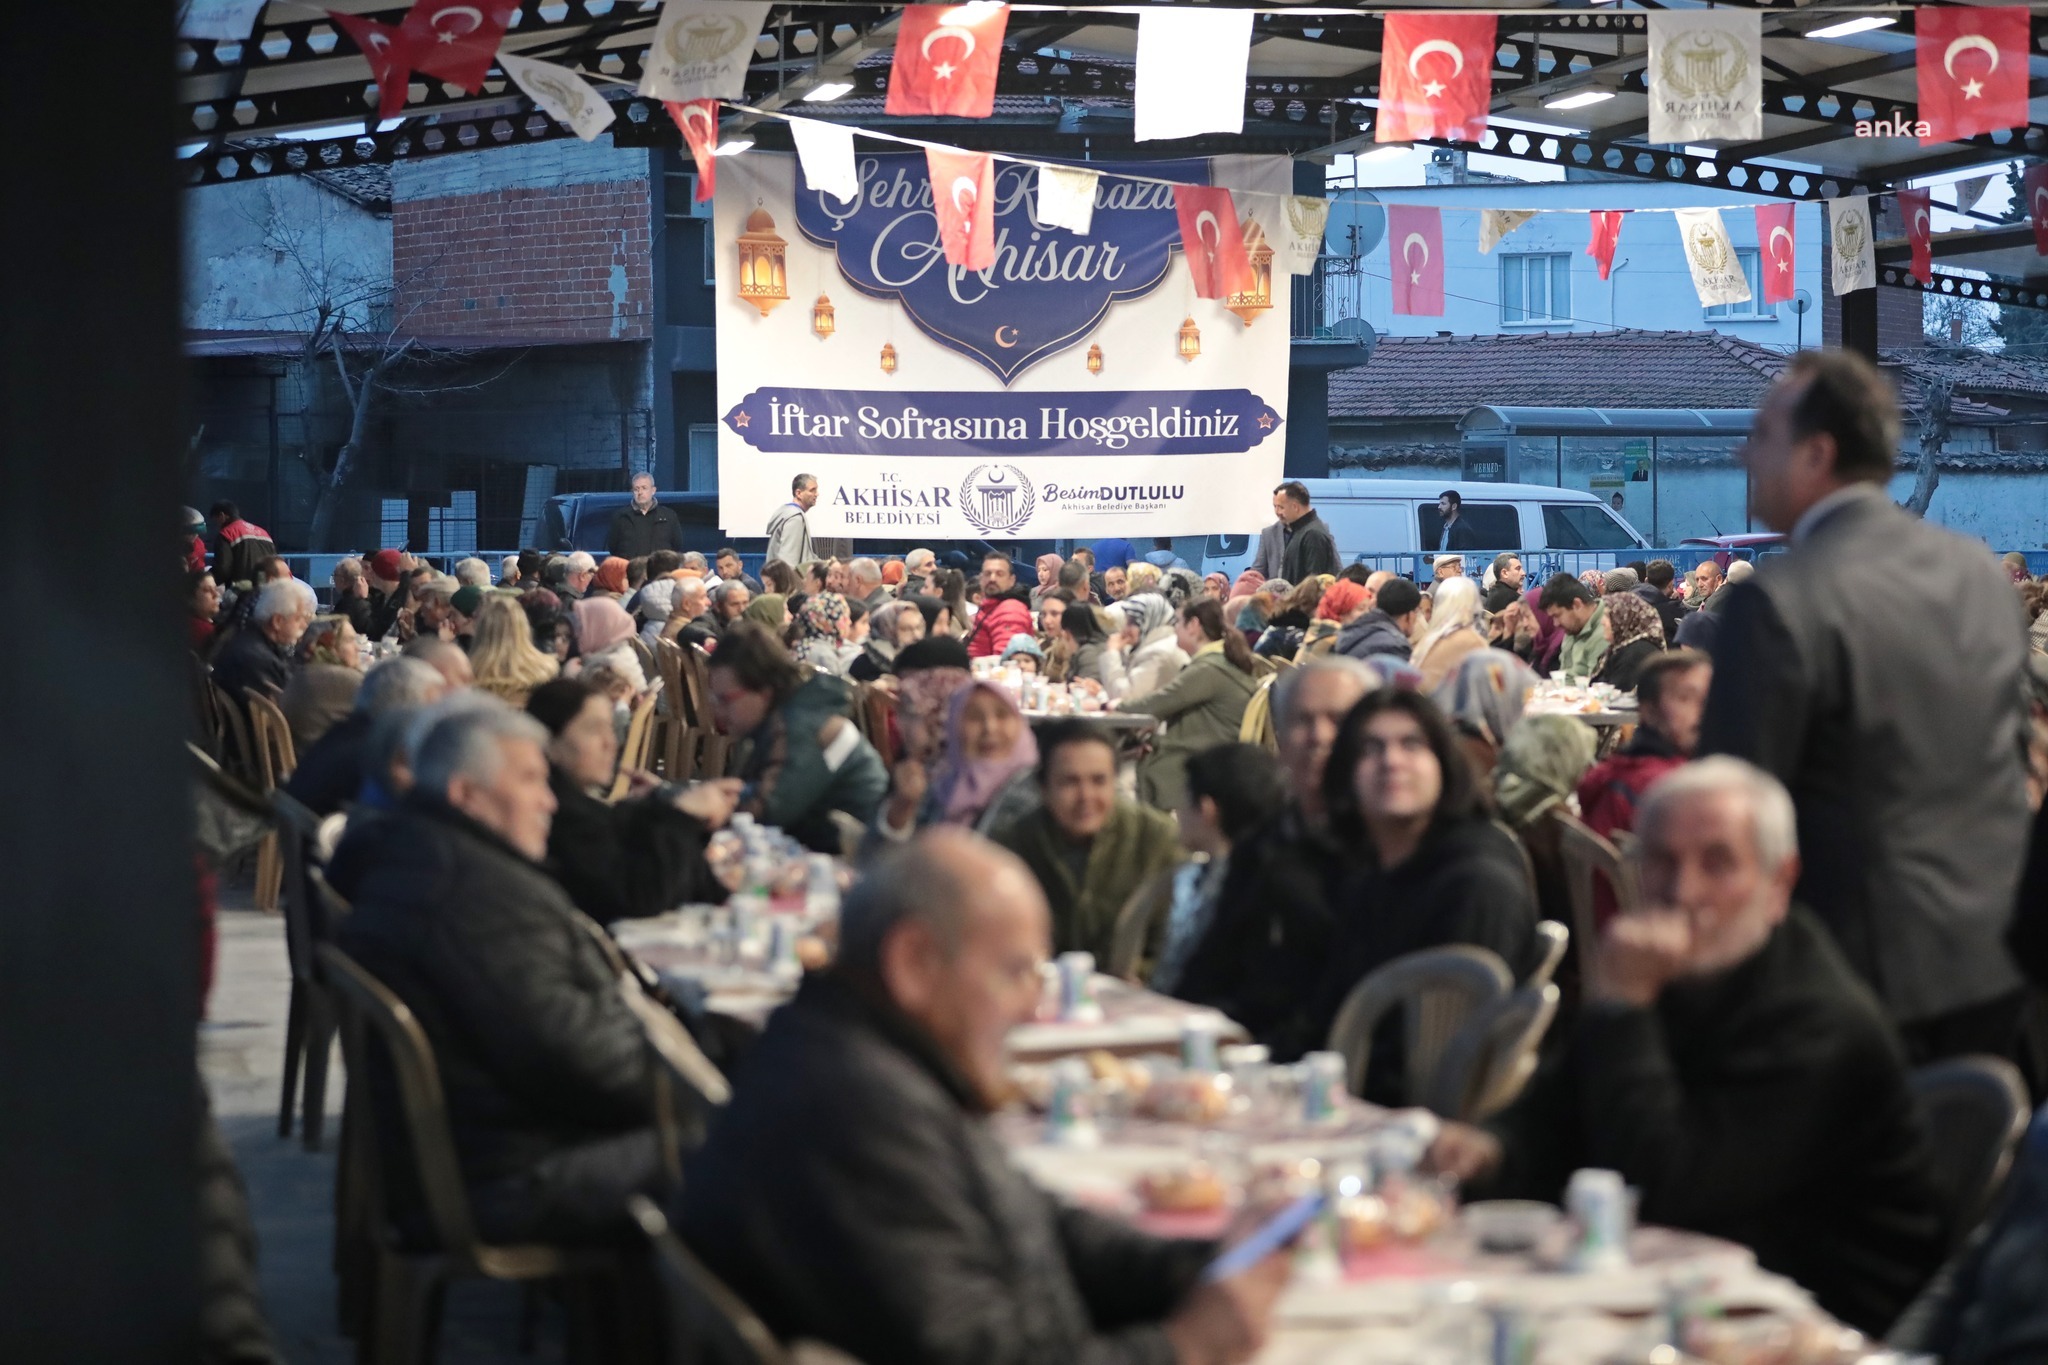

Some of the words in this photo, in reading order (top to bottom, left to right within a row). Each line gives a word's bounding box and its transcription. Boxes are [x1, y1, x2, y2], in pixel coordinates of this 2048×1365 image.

[870, 209, 1126, 304] Ahisar
[768, 396, 849, 437] İftar
[858, 406, 1029, 440] Sofrasına
[1038, 406, 1239, 449] Hoşgeldiniz
[880, 472, 902, 482] T.C.
[832, 484, 953, 507] AKHİSAR
[1096, 503, 1133, 511] Belediye
[1135, 502, 1167, 511] Başkanı
[845, 509, 940, 525] BELEDİYESİ
